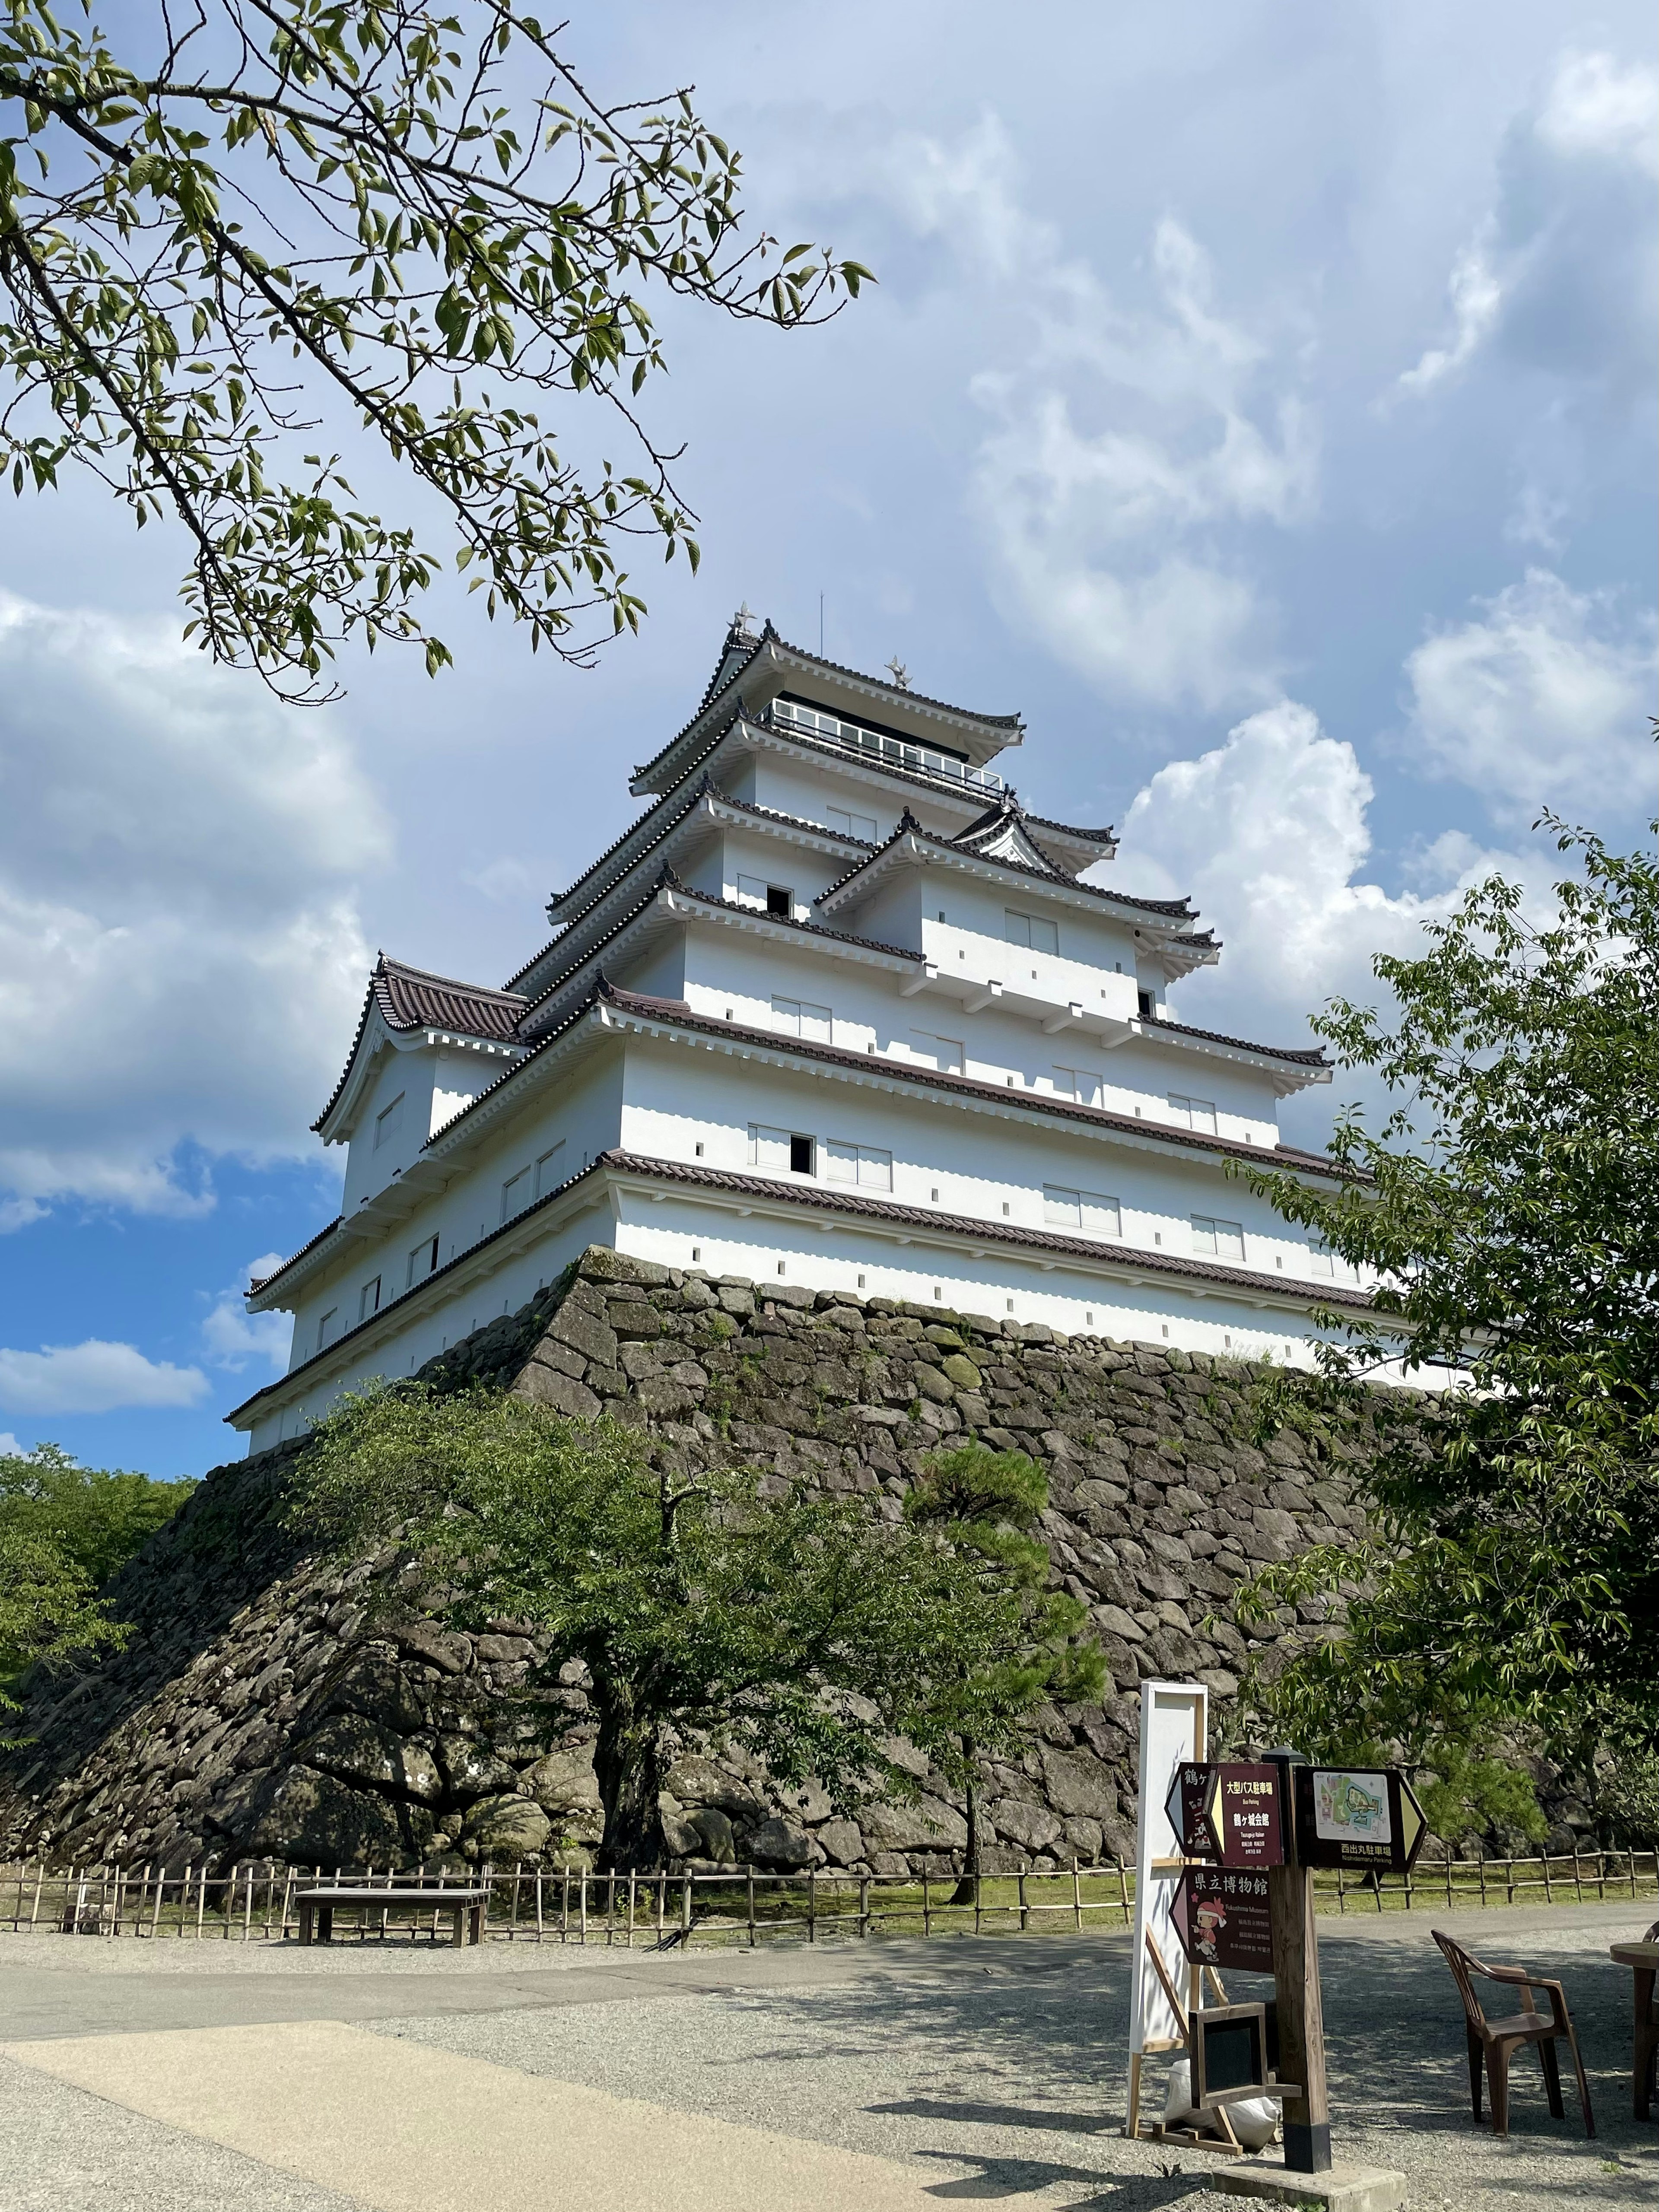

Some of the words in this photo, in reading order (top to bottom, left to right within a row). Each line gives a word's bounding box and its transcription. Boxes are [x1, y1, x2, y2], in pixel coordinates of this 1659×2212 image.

[1184, 1769, 1211, 1785] 鶴ヶ
[1227, 1781, 1273, 1795] 大型バス駐車場
[1233, 1813, 1269, 1827] 鶴ヶ城会館
[1341, 1843, 1391, 1856] 西出丸駐車場
[1195, 1873, 1268, 1896] 県立博物館
[1226, 1904, 1249, 1912] Fukushima
